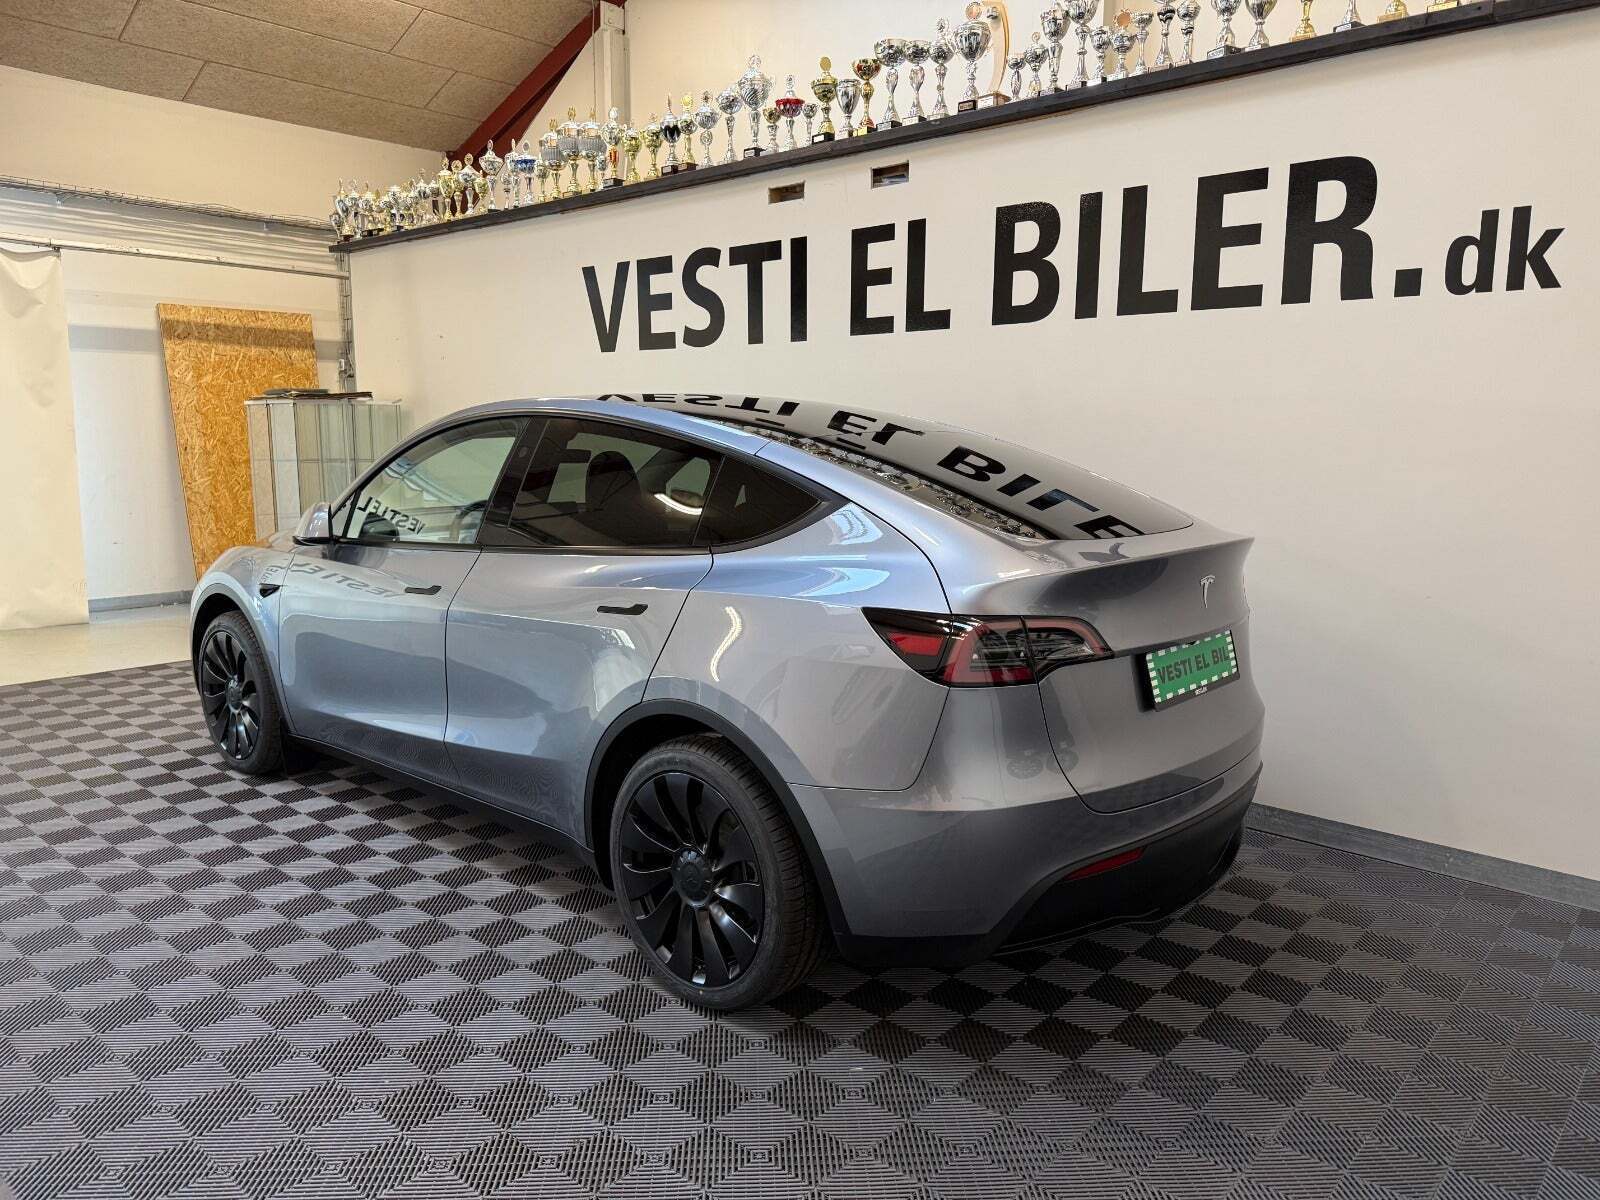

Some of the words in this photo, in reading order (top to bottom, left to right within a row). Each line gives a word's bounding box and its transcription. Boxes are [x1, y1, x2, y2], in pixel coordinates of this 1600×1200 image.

[581, 235, 808, 353] VESTI
[849, 217, 951, 337] EL
[1157, 658, 1193, 684] VESTI
[1194, 653, 1210, 672] EL
[1211, 646, 1230, 665] BIL
